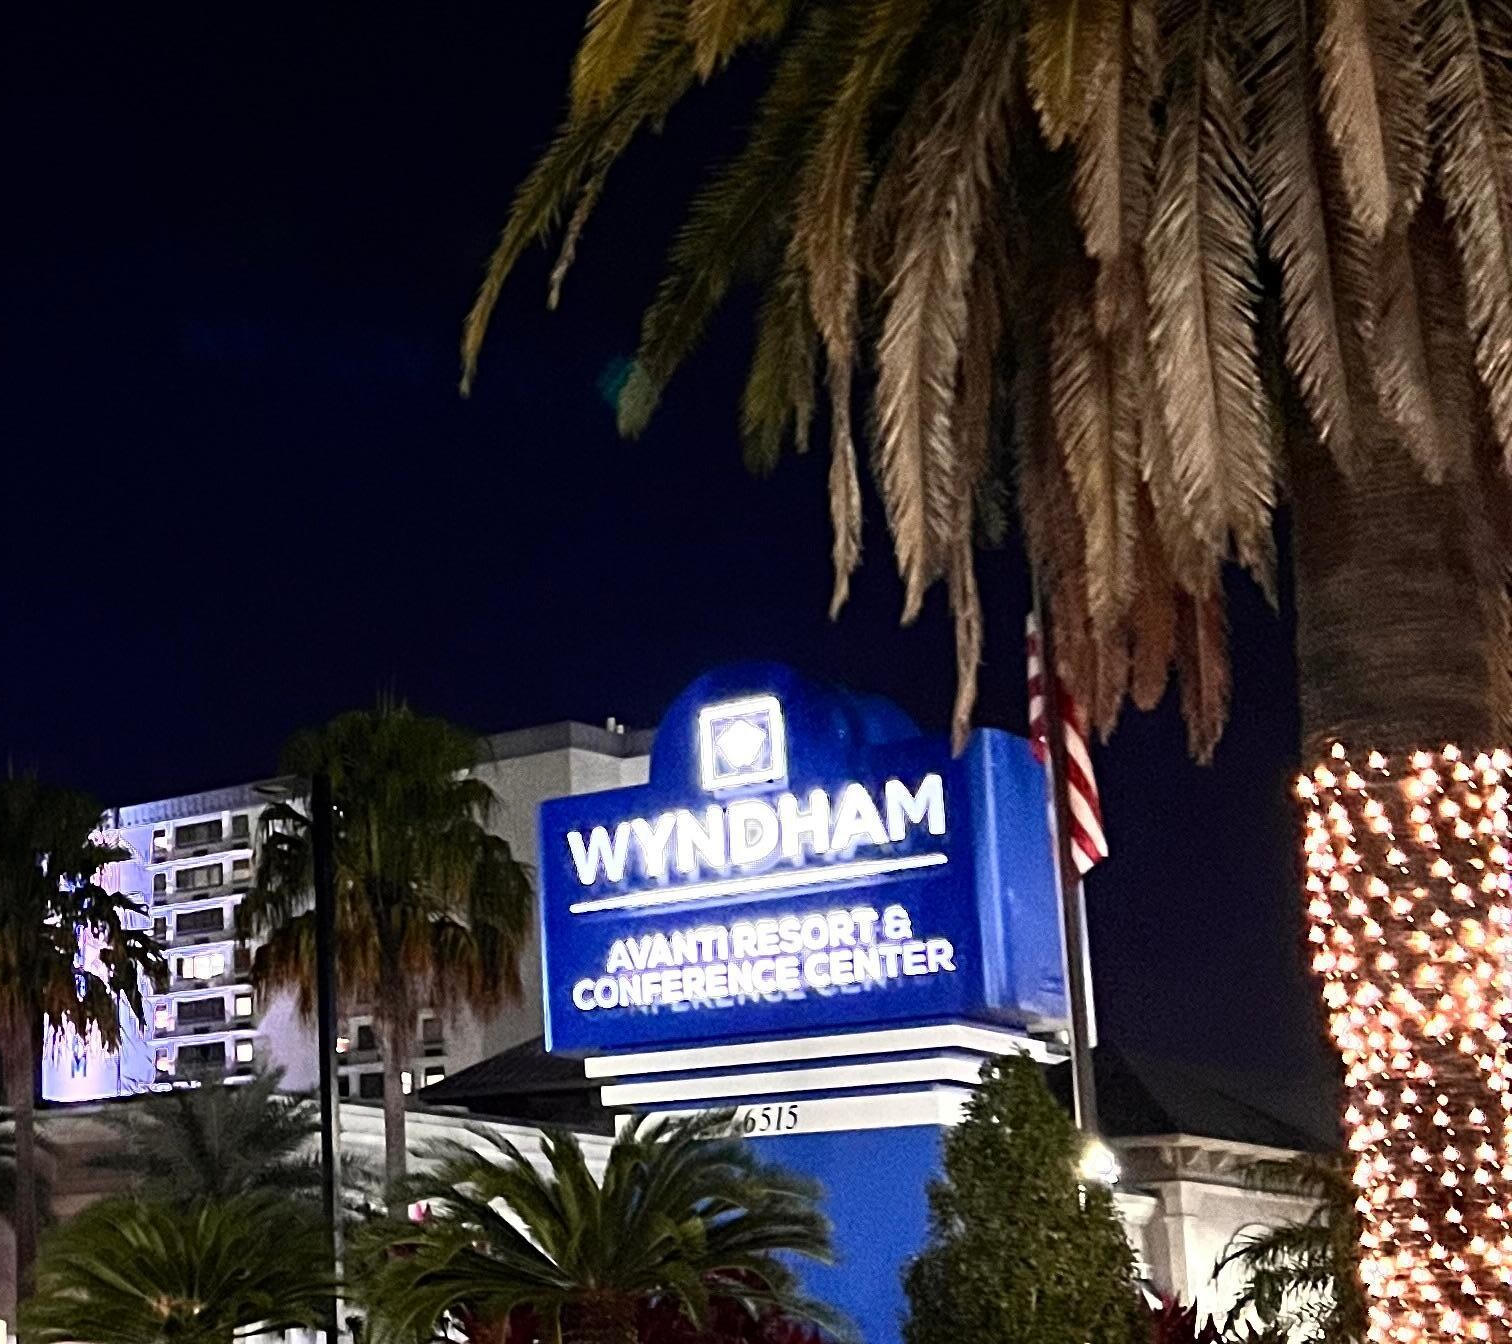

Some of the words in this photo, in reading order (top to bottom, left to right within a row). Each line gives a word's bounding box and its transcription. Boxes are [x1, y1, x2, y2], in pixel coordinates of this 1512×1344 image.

[567, 774, 948, 887] WYNDHAM
[606, 924, 728, 973] AVANTI
[731, 906, 879, 959] RESORT
[883, 904, 913, 939] &
[572, 955, 801, 1011] CONFERENCE
[803, 938, 956, 988] CENTER
[743, 1104, 798, 1134] 6515
